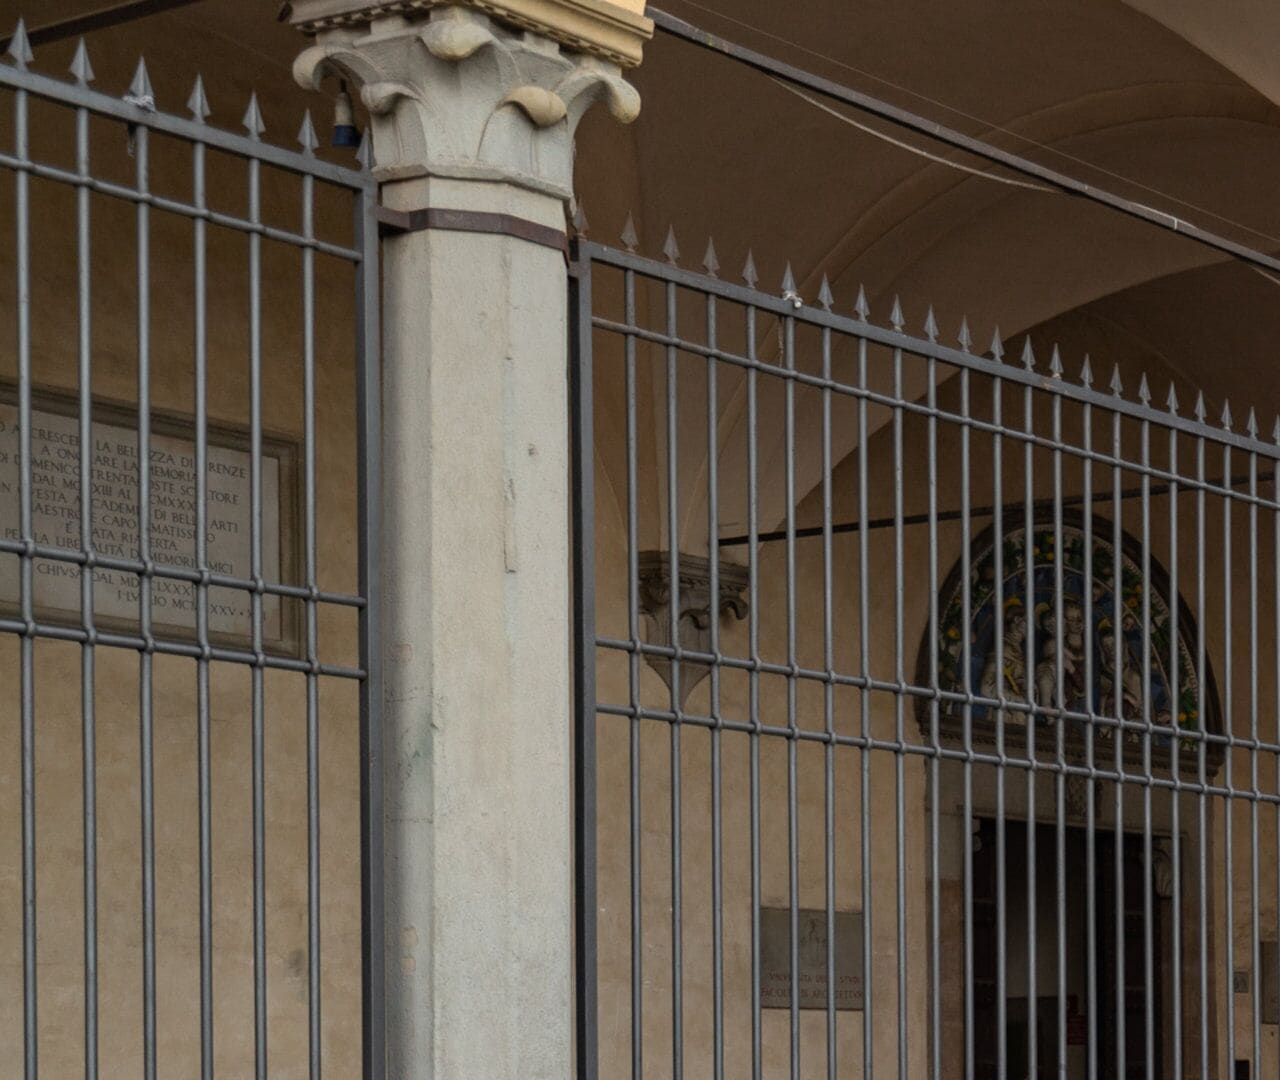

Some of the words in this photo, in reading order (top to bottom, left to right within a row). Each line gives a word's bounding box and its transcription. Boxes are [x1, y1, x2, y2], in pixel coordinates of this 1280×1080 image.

[57, 448, 118, 469] ONARE
[150, 465, 198, 483] EMORIA
[117, 444, 176, 466] BELZZA
[206, 461, 247, 479] RENZE
[210, 519, 239, 533] ARTI
